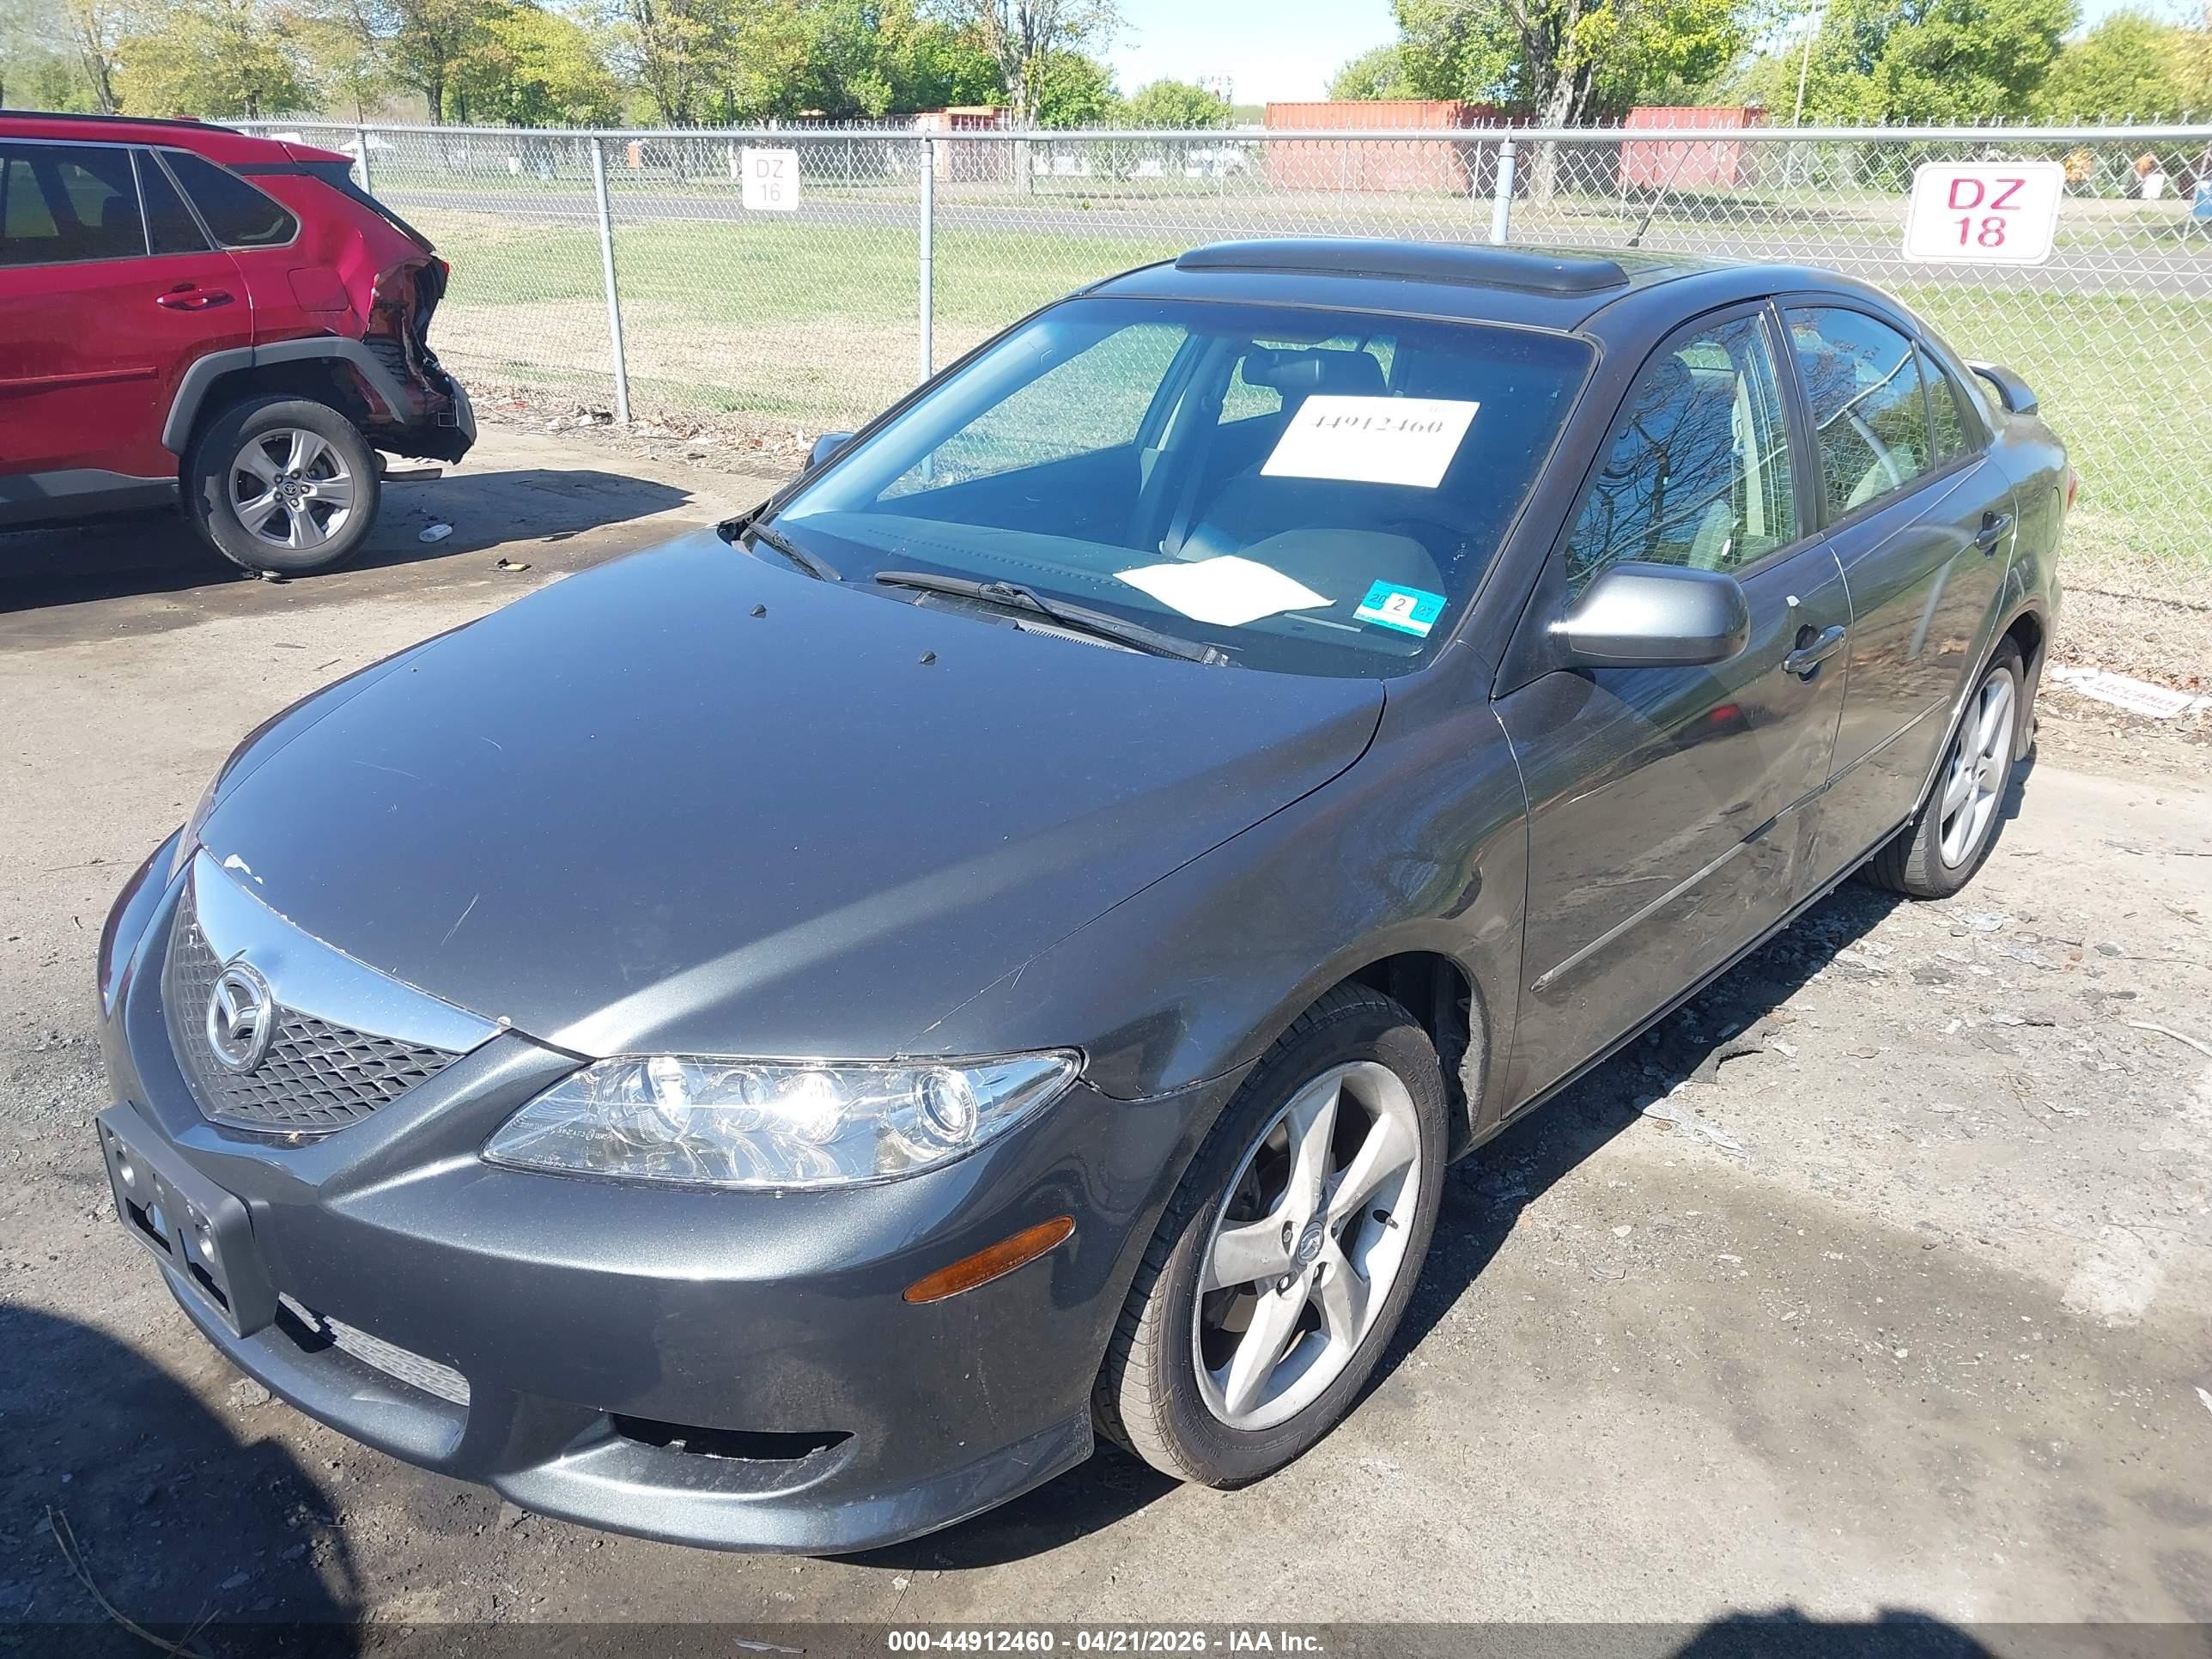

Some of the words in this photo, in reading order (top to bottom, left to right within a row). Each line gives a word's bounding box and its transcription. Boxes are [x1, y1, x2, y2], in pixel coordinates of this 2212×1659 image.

[756, 159, 784, 179] DZ
[759, 182, 781, 202] 16
[1947, 178, 2027, 210] DZ
[1954, 216, 2007, 248] 18
[1310, 414, 1443, 434] 44912460
[1392, 598, 1407, 611] 2
